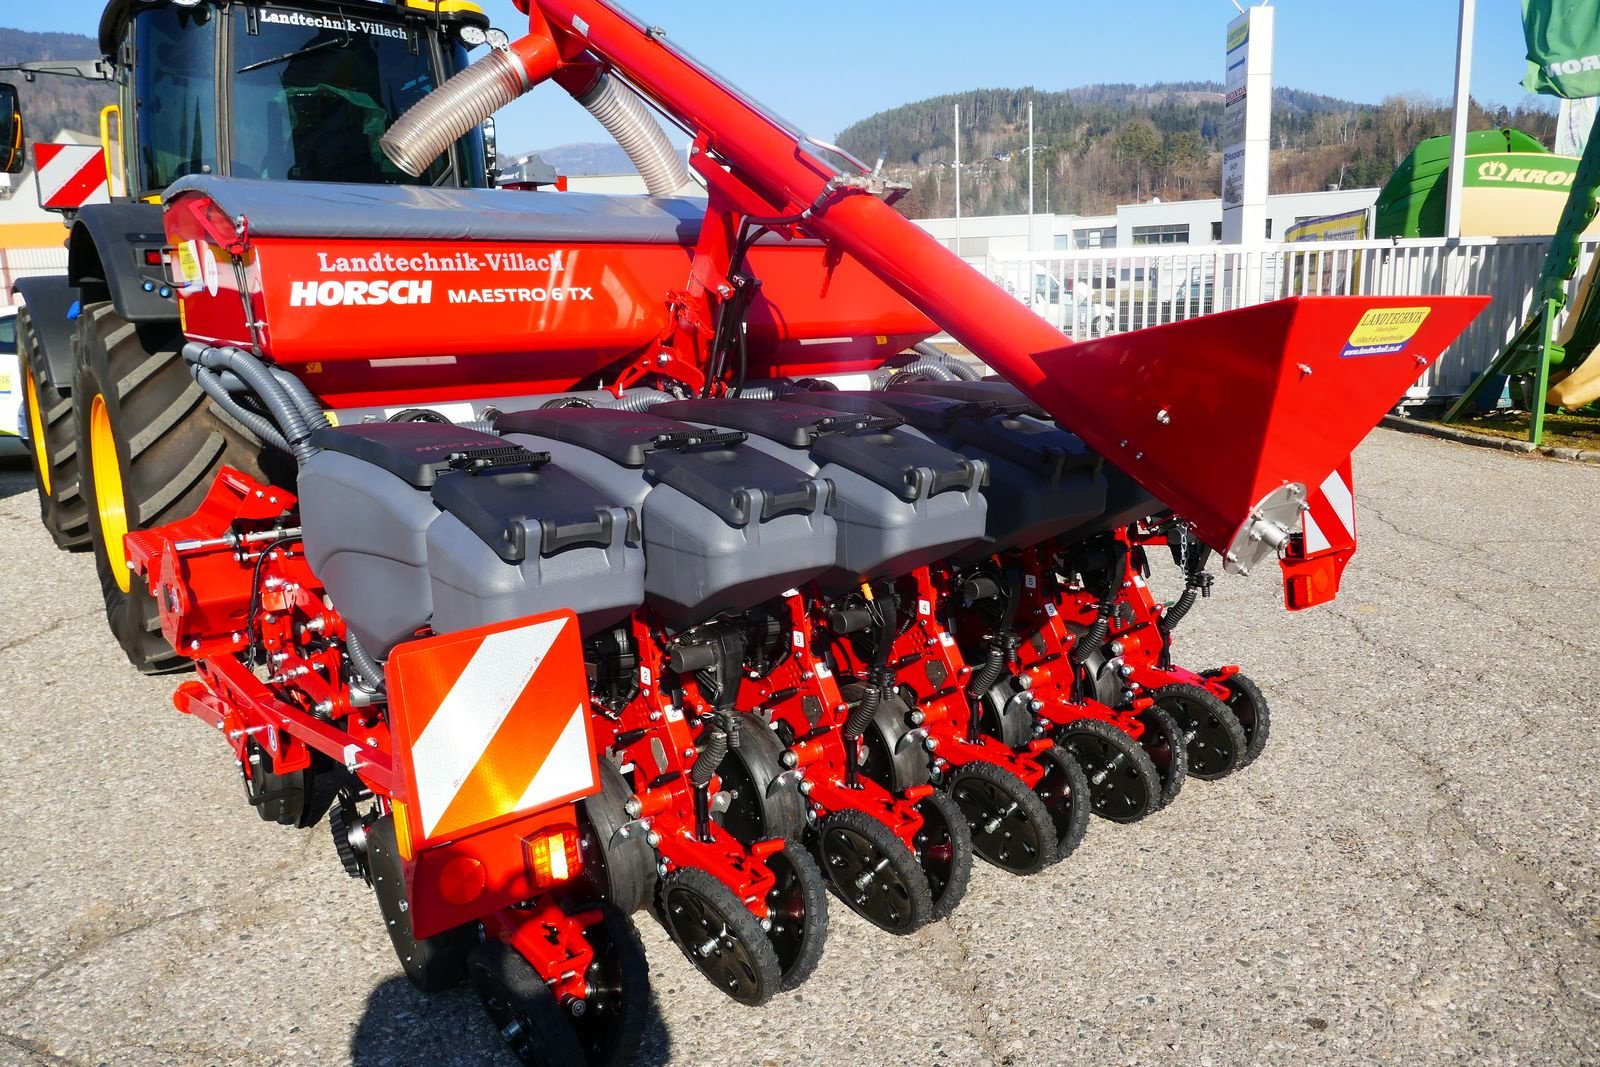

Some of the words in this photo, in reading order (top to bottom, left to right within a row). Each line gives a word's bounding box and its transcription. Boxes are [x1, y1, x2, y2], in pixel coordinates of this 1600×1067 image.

[259, 9, 408, 40] Landtechnik-Villach
[1225, 86, 1246, 102] HONDA
[316, 252, 564, 273] Landtechnik-Villach
[290, 280, 432, 306] HORSCH
[447, 287, 546, 303] MAESTRO
[551, 287, 562, 301] 6
[569, 287, 594, 301] TX
[1361, 312, 1425, 326] LANDTECHNIK
[1028, 577, 1034, 586] 5
[643, 671, 648, 681] 2
